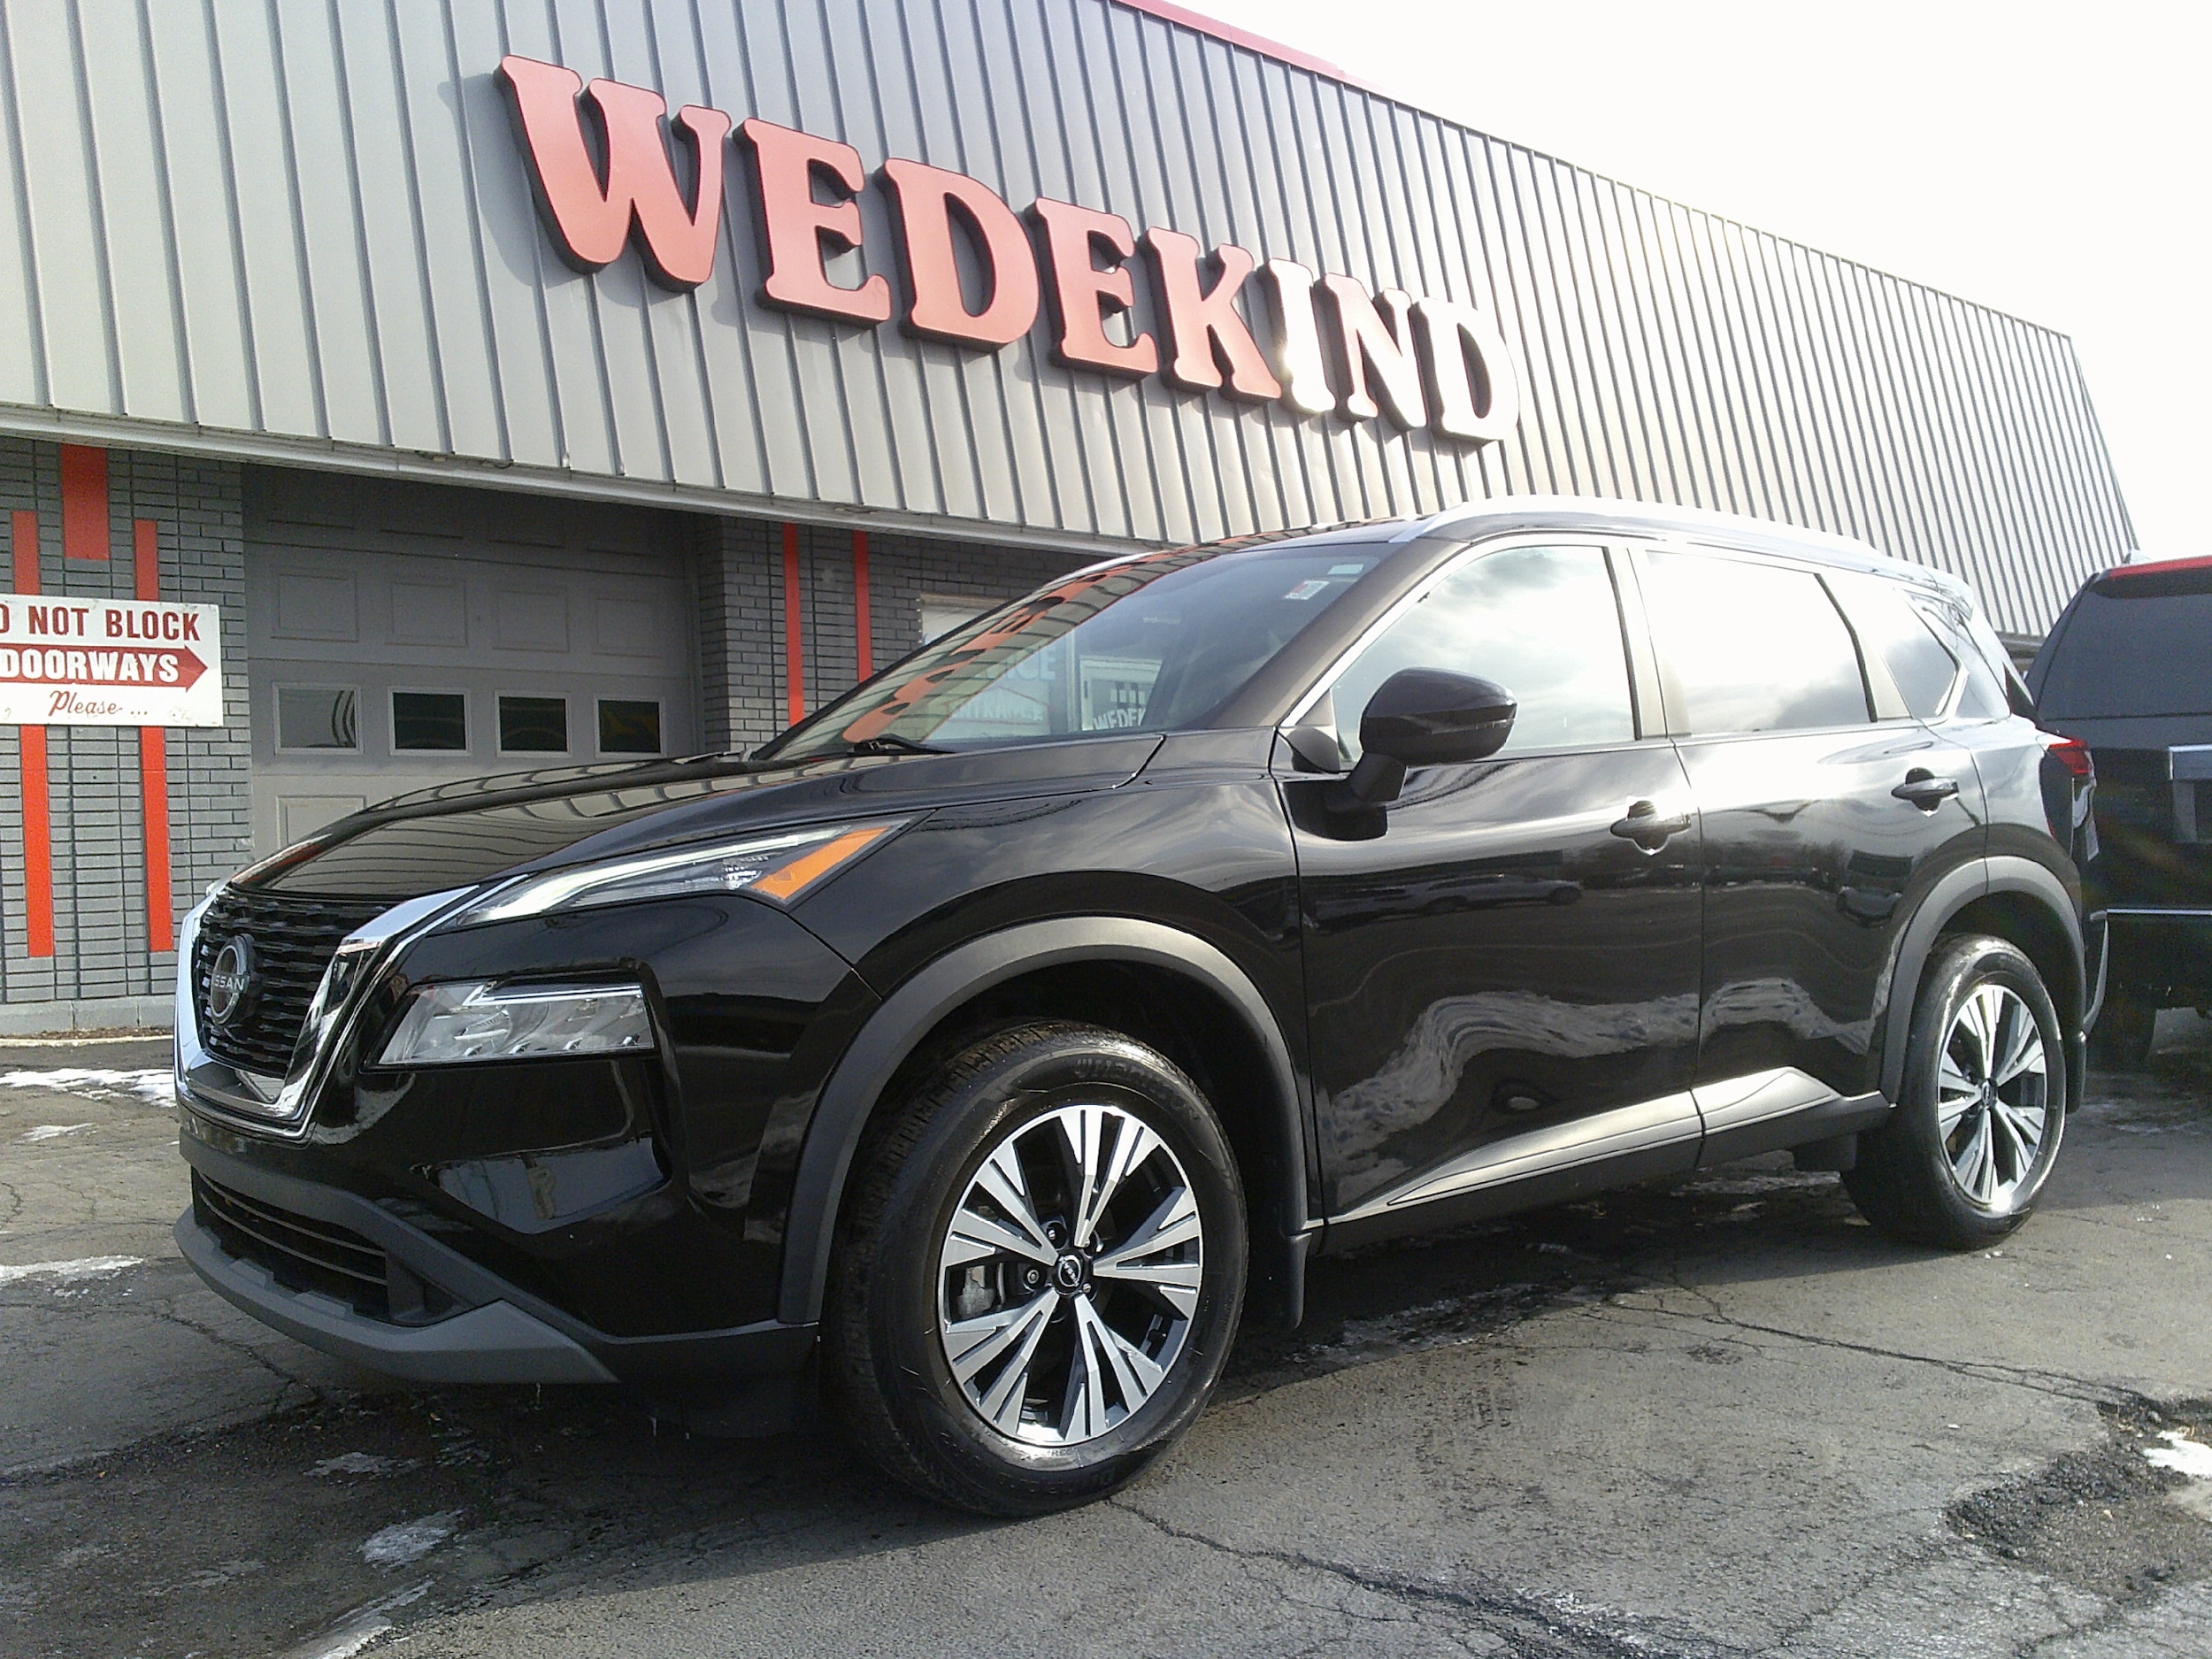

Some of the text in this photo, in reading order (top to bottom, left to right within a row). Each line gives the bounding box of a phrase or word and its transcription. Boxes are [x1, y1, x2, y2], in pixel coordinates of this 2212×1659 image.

[497, 54, 1521, 442] WEDEKIND
[28, 605, 89, 637] NOT
[105, 609, 201, 641] BLOCK
[0, 648, 180, 683] DOORWAYS
[49, 689, 123, 717] Please
